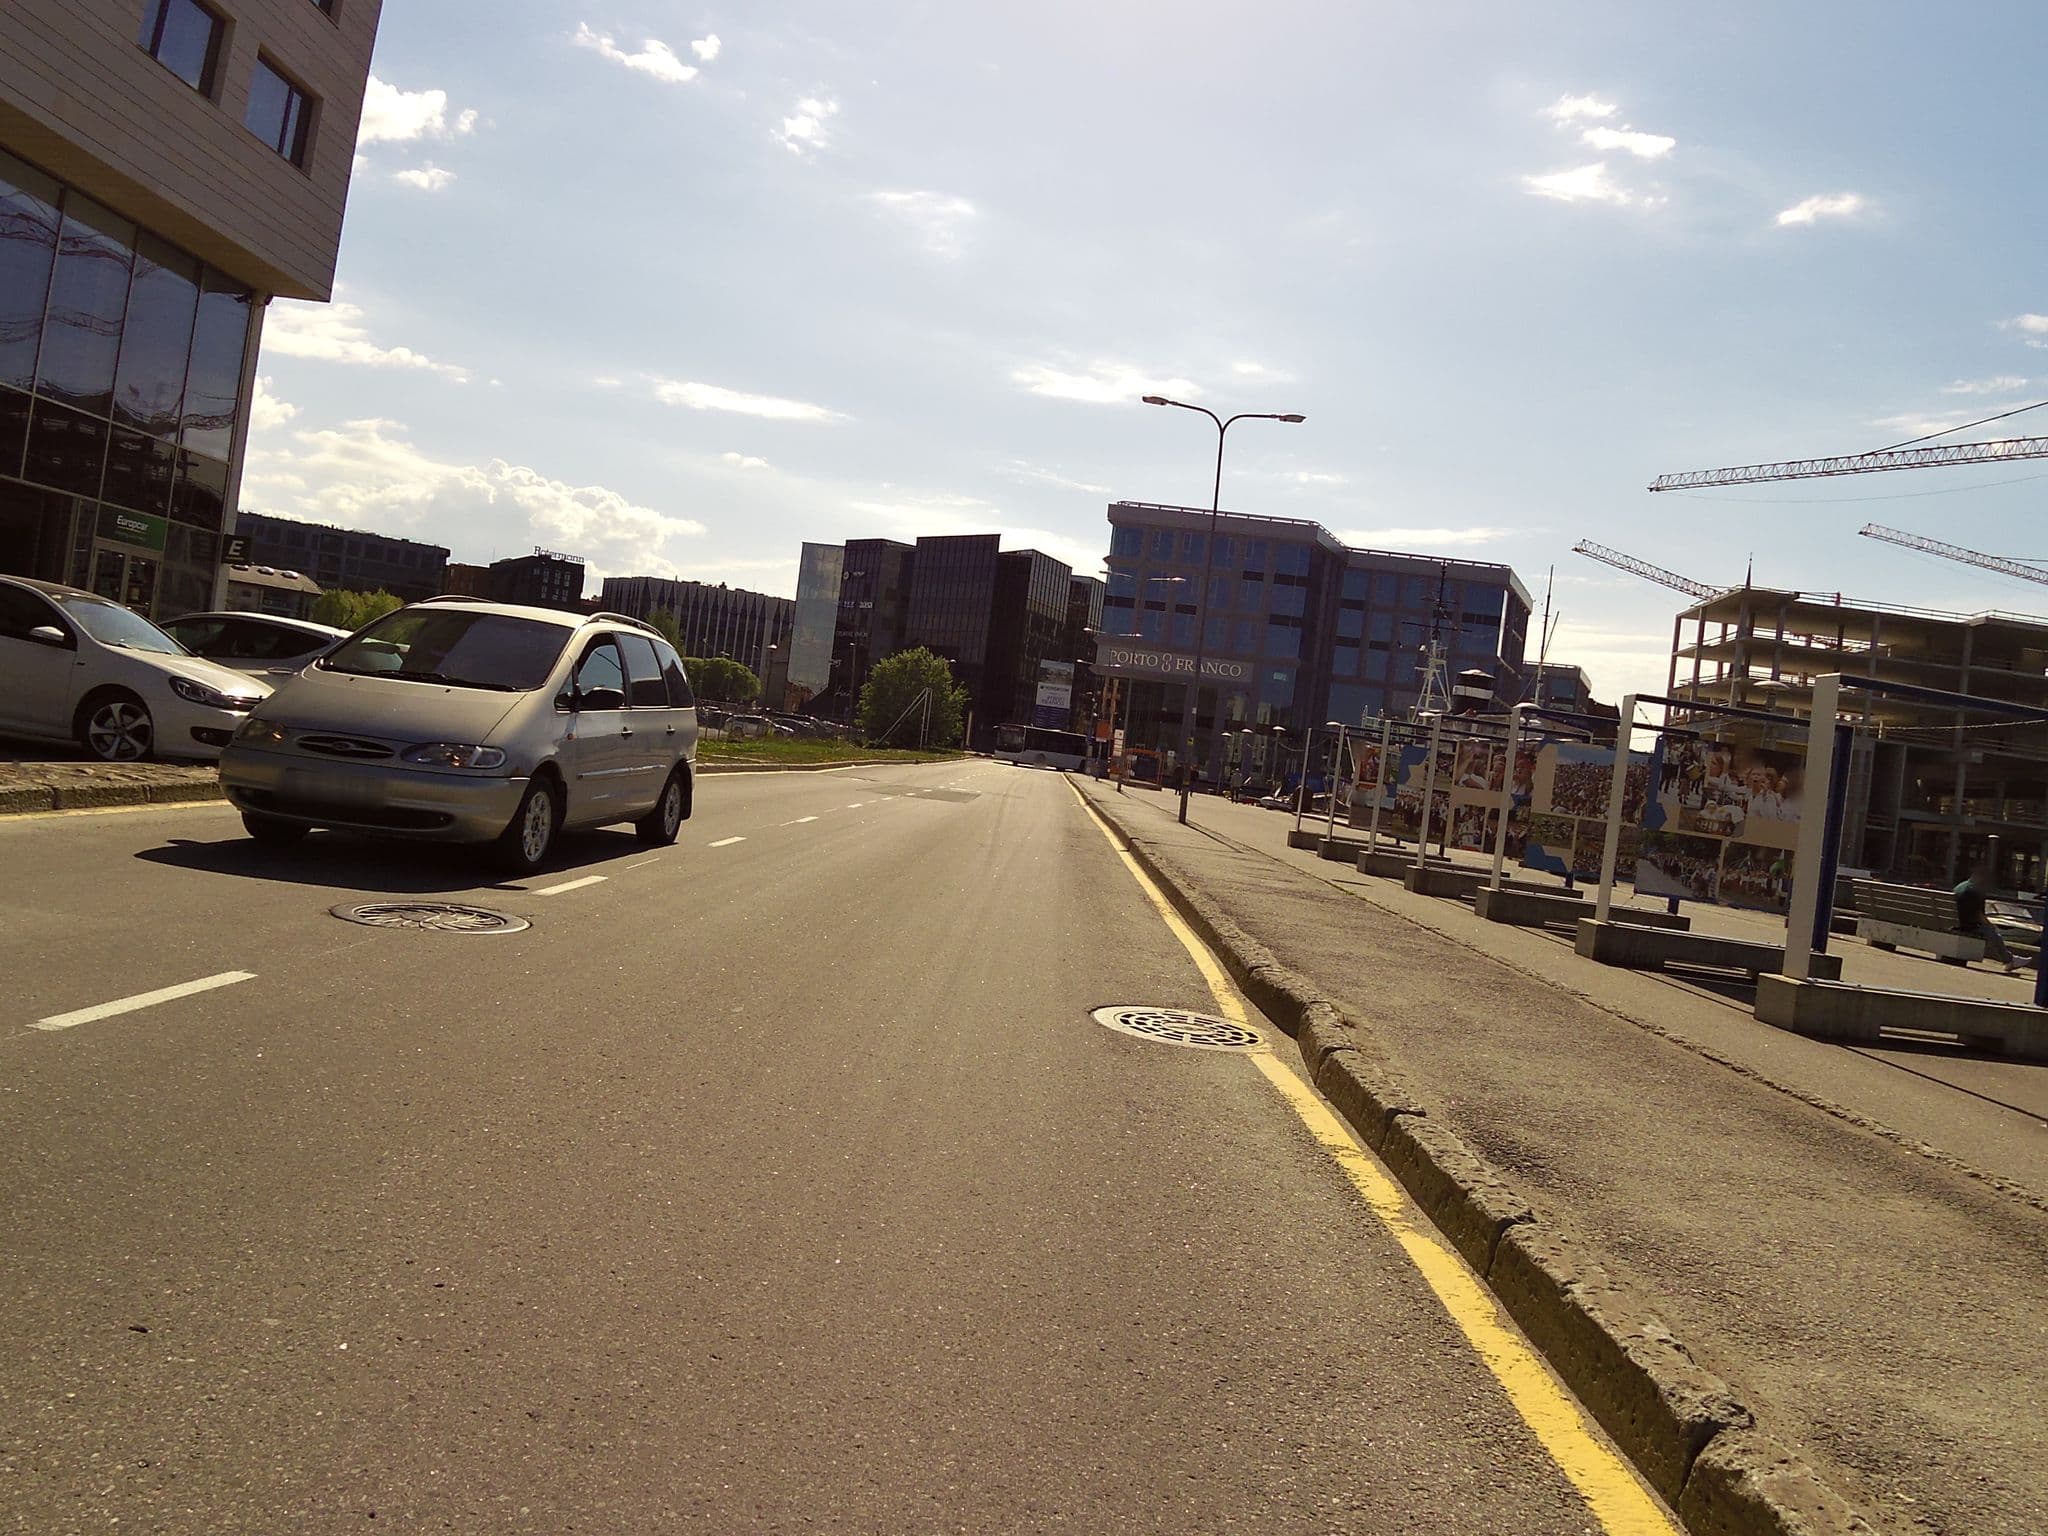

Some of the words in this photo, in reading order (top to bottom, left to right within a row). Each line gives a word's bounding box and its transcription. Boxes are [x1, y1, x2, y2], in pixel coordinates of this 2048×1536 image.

[116, 514, 149, 531] Europcar
[228, 540, 244, 555] E
[1111, 650, 1158, 667] PORTO
